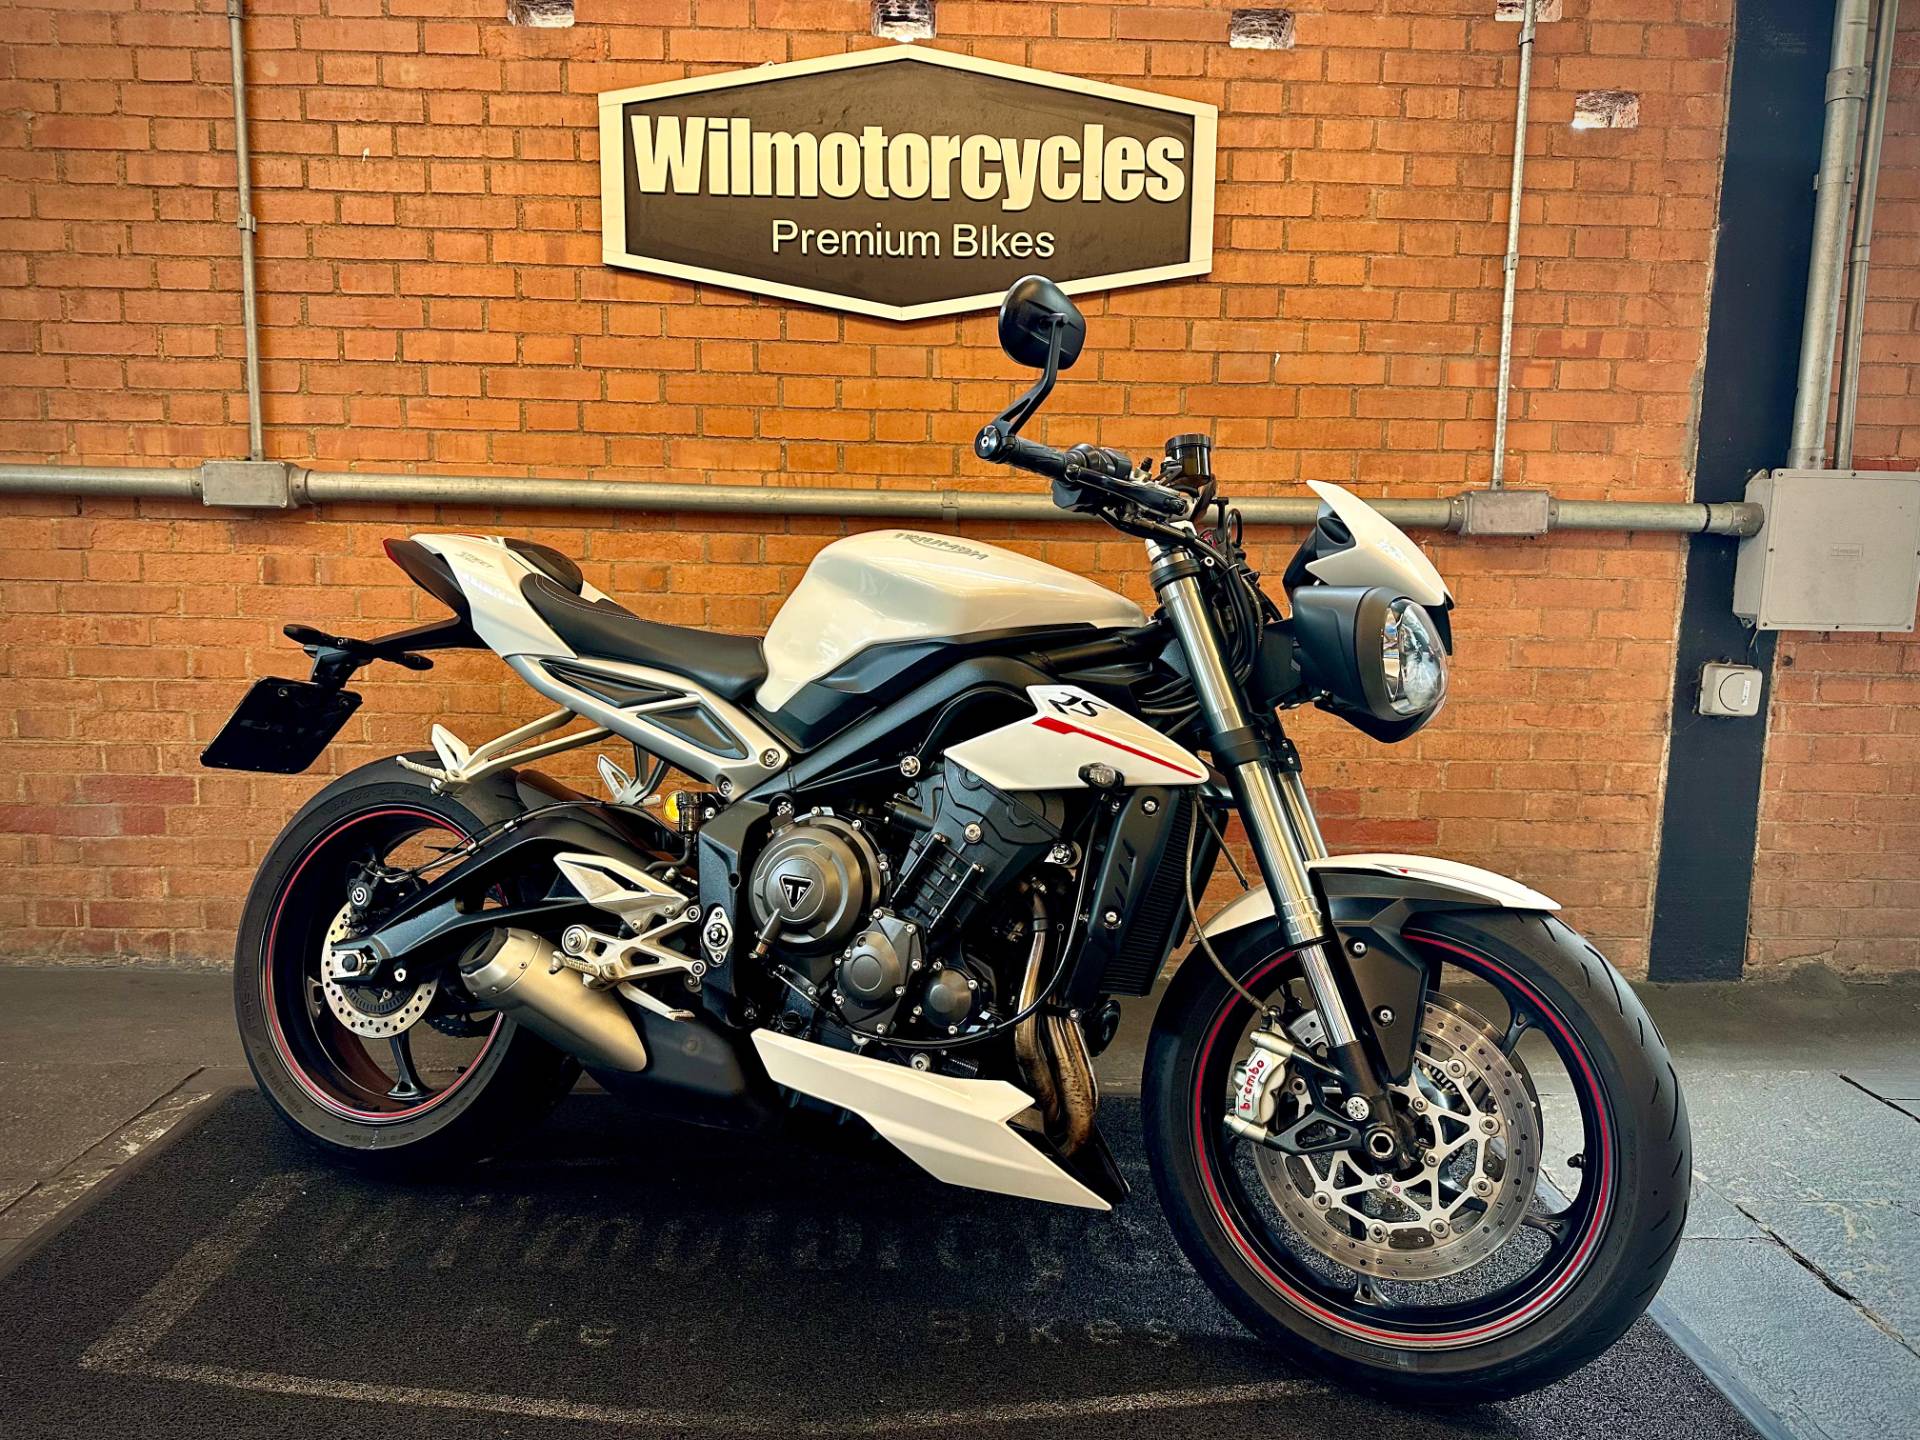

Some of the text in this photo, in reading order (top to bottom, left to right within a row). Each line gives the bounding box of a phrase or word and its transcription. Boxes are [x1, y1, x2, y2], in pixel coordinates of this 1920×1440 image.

[630, 114, 1186, 211] Wilmotorcycles
[771, 219, 941, 258] Premium
[1239, 1059, 1266, 1112] brembo
